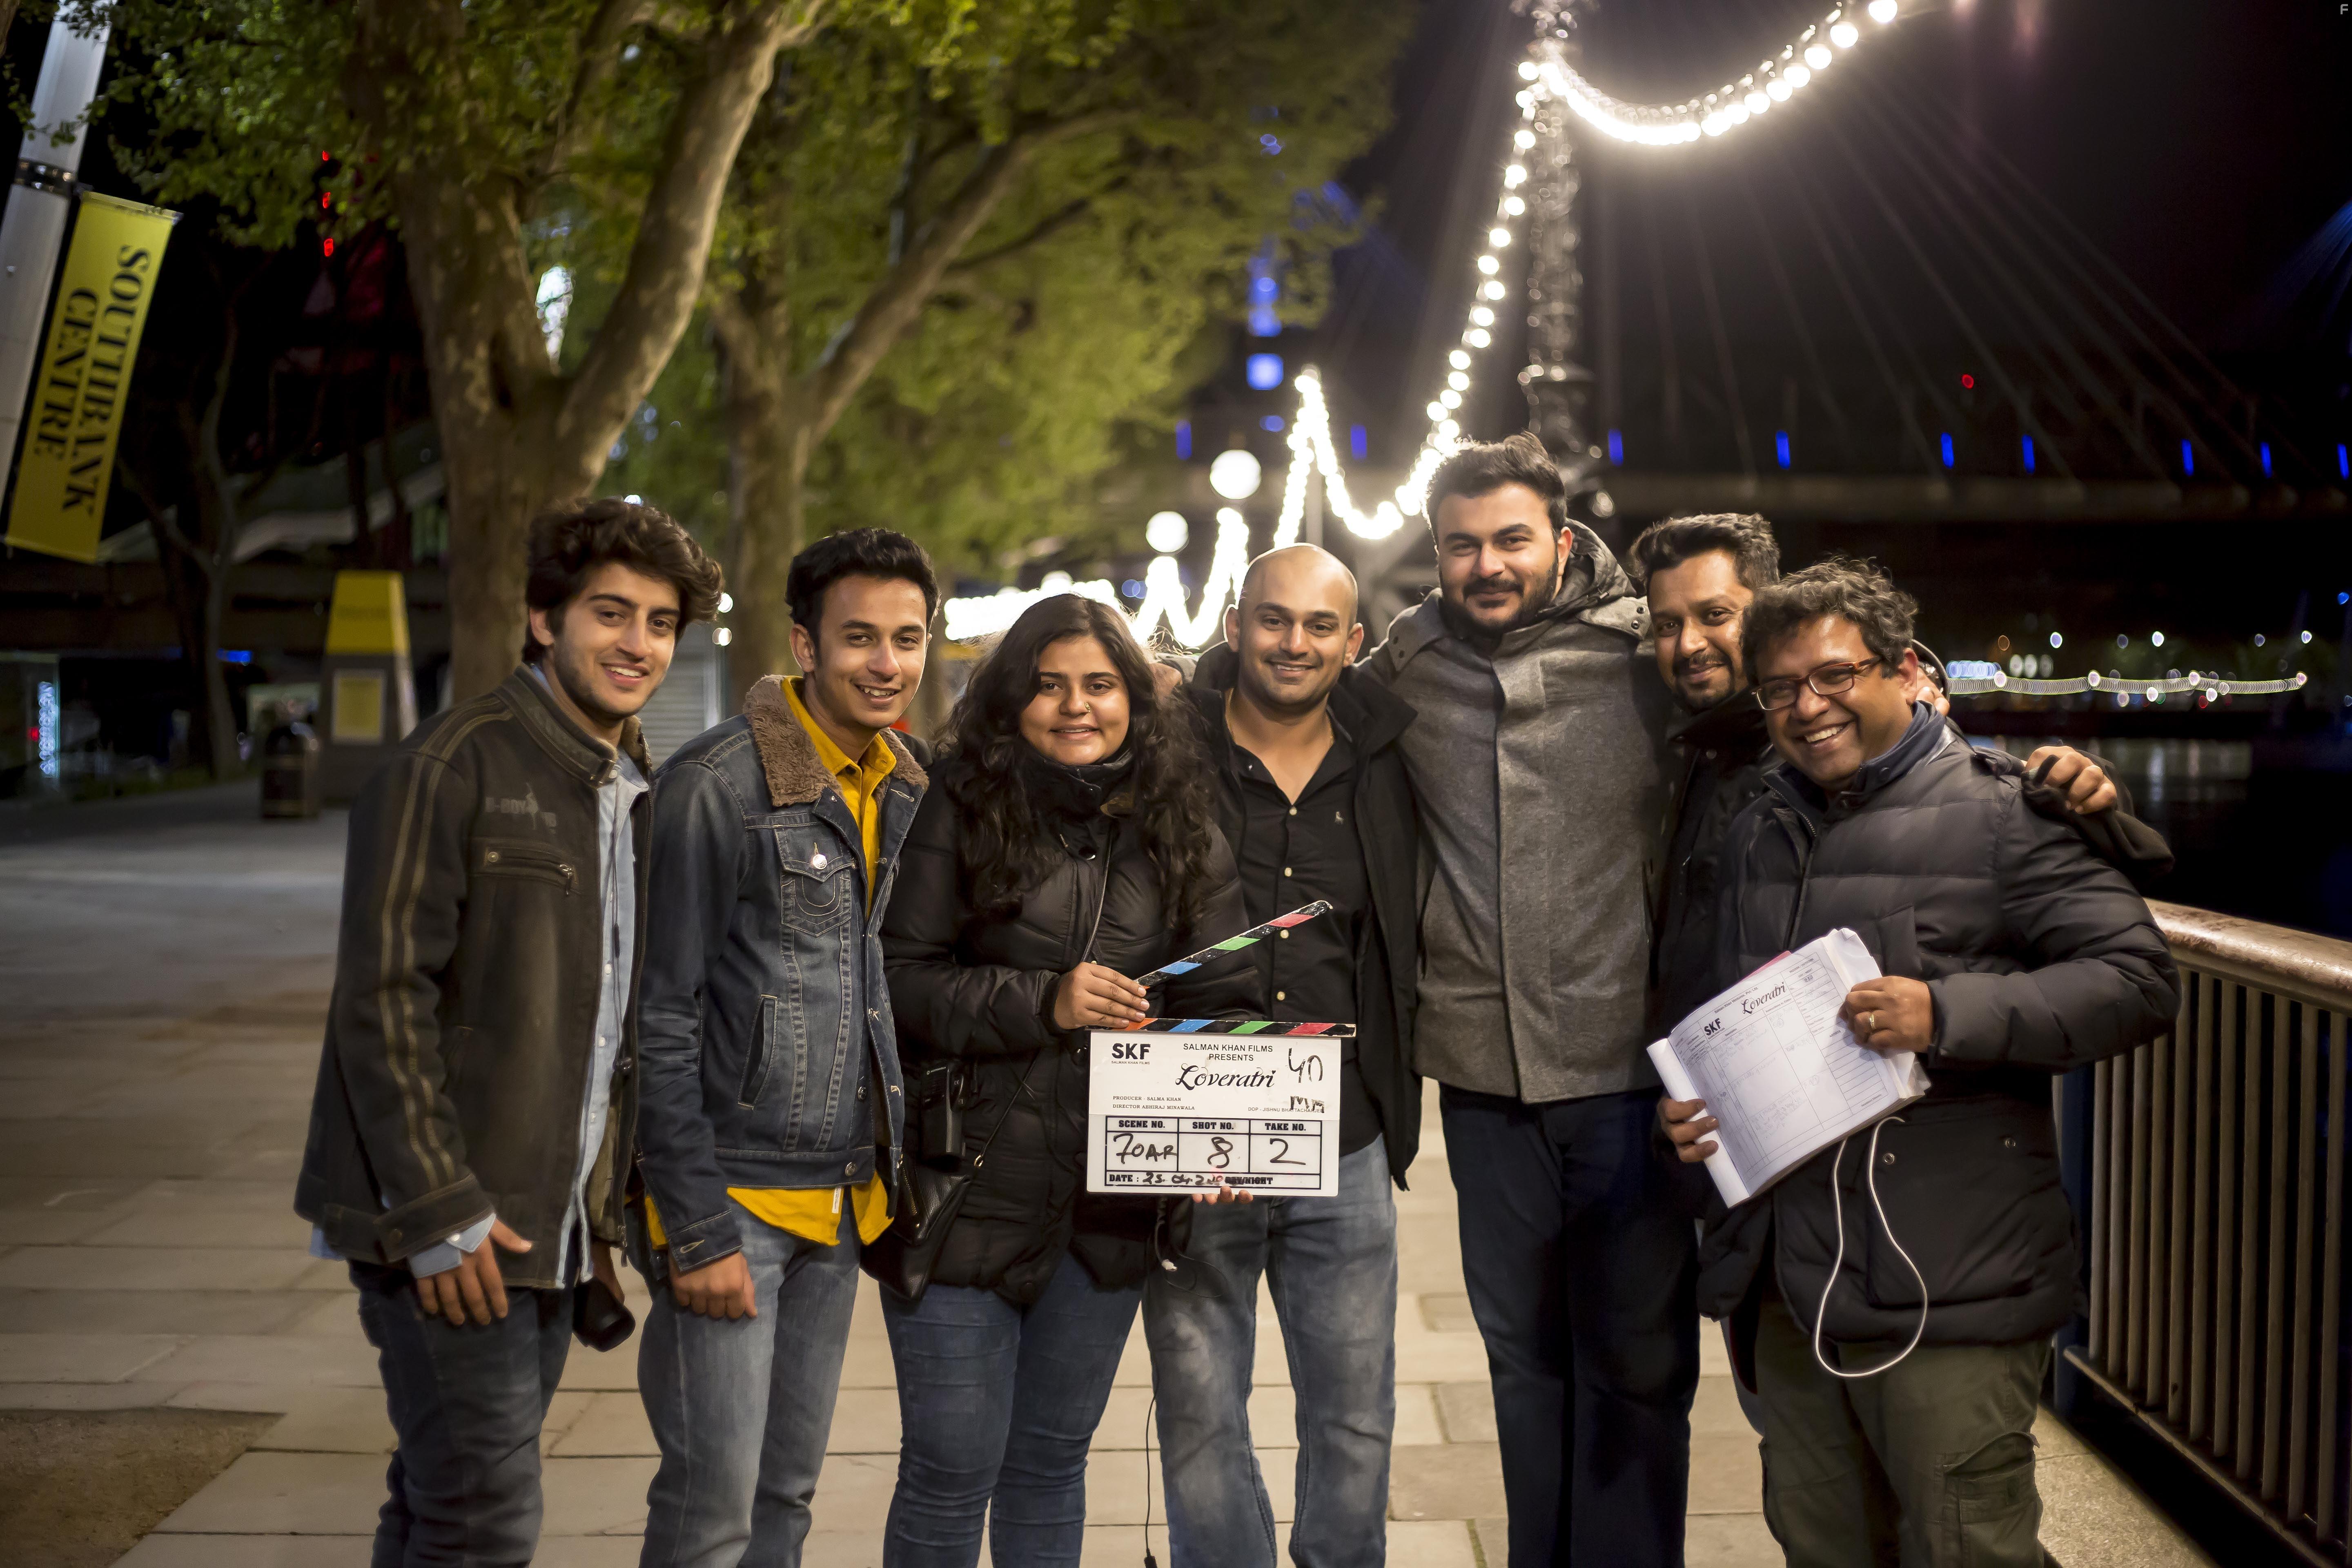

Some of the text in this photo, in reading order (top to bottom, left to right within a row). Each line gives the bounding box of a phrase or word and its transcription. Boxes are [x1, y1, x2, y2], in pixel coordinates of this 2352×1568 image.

[34, 287, 98, 461] CENTRE
[62, 245, 151, 516] SOUTHBANK
[1740, 982, 1787, 1014] Loveratri
[1704, 1018, 1721, 1036] SKF
[1111, 1043, 1151, 1060] SKF
[1175, 1063, 1276, 1091] Loveratri
[1207, 1136, 1233, 1168] 8
[1270, 1138, 1306, 1165] 2
[1109, 1174, 1133, 1182] DATE
